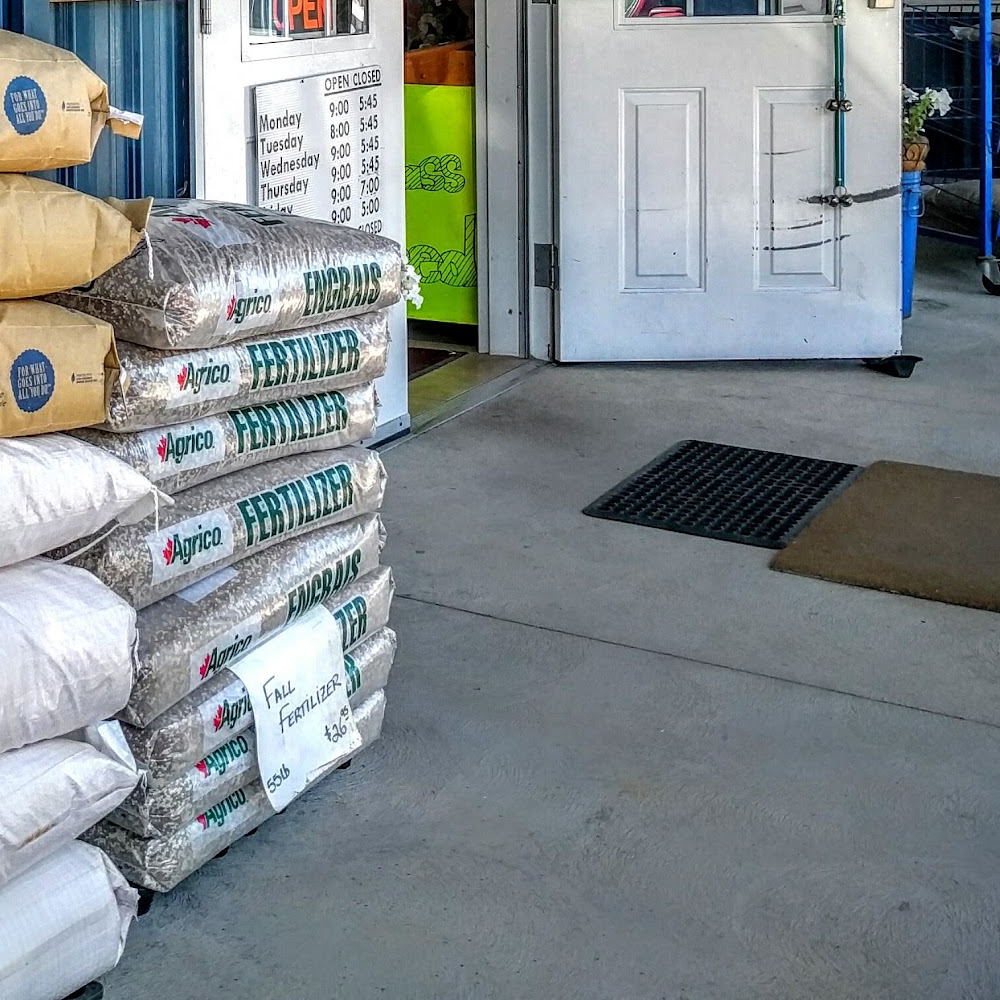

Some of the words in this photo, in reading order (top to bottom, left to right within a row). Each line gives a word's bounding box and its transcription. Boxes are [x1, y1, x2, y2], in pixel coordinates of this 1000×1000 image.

[9, 92, 23, 102] FOR
[23, 88, 38, 100] WHAT
[324, 74, 349, 91] OPEN
[352, 69, 381, 86] CLOSED
[12, 102, 27, 113] GOES
[27, 100, 40, 112] INTO
[16, 113, 25, 124] ALL
[259, 109, 302, 133] Monday
[329, 99, 349, 117] 9:00
[359, 93, 378, 111] 5:45
[260, 133, 304, 155] Tuesday
[330, 121, 350, 139] 8:00
[359, 114, 378, 132] 5:45
[260, 151, 320, 178] Wednesday
[331, 142, 351, 161] 9:00
[360, 135, 379, 153] 5:45
[260, 176, 309, 201] Thursday
[331, 163, 351, 182] 9:00
[361, 155, 380, 174] 5:45
[331, 185, 351, 204] 9:00
[360, 177, 380, 196] 7:00
[331, 206, 351, 223] 9:00
[361, 197, 380, 217] 5:00
[302, 261, 382, 317] ENGRAIS
[17, 366, 29, 378] FOR
[29, 362, 45, 375] WHAT
[17, 377, 33, 389] GOES
[33, 373, 47, 387] INTO
[183, 358, 231, 396] Agrico
[246, 328, 361, 390] FERTILIZER
[18, 388, 30, 400] ALL
[164, 425, 215, 464] Agrico
[227, 390, 348, 454] FERTILIZER
[170, 524, 223, 566] Agrico
[235, 462, 354, 548] FERTILIZER
[205, 634, 252, 677] Agrico
[287, 548, 362, 623] ENGRAIS
[219, 686, 252, 729] Agri
[262, 675, 296, 709] FALL
[278, 673, 342, 734] FERTILIZER
[204, 735, 249, 776] Agrico
[204, 787, 247, 828] Agrico
